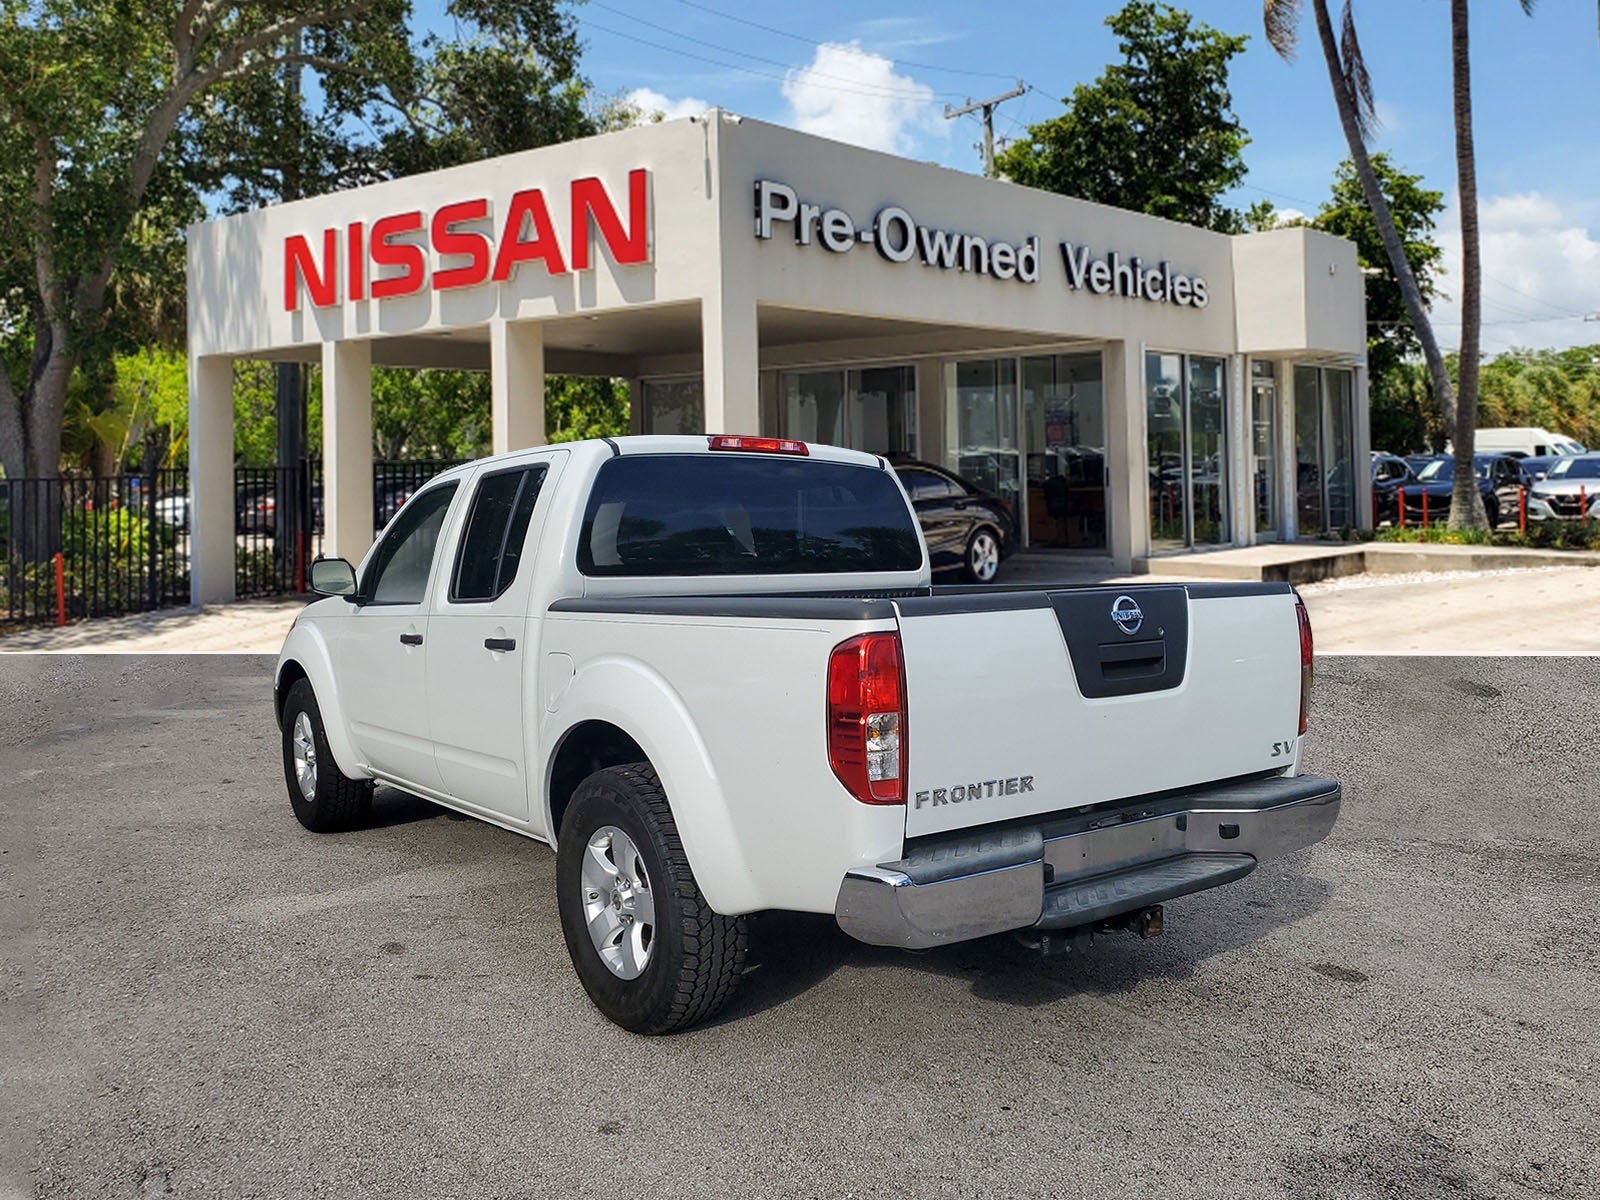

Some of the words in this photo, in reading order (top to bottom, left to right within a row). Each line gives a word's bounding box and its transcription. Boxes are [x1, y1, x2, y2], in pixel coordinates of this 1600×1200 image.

[285, 168, 648, 312] NISSAN
[754, 179, 1040, 284] Pre-Owned
[1059, 241, 1209, 309] Vehicles
[1270, 739, 1295, 757] SV
[914, 775, 1035, 810] FRONTIER
